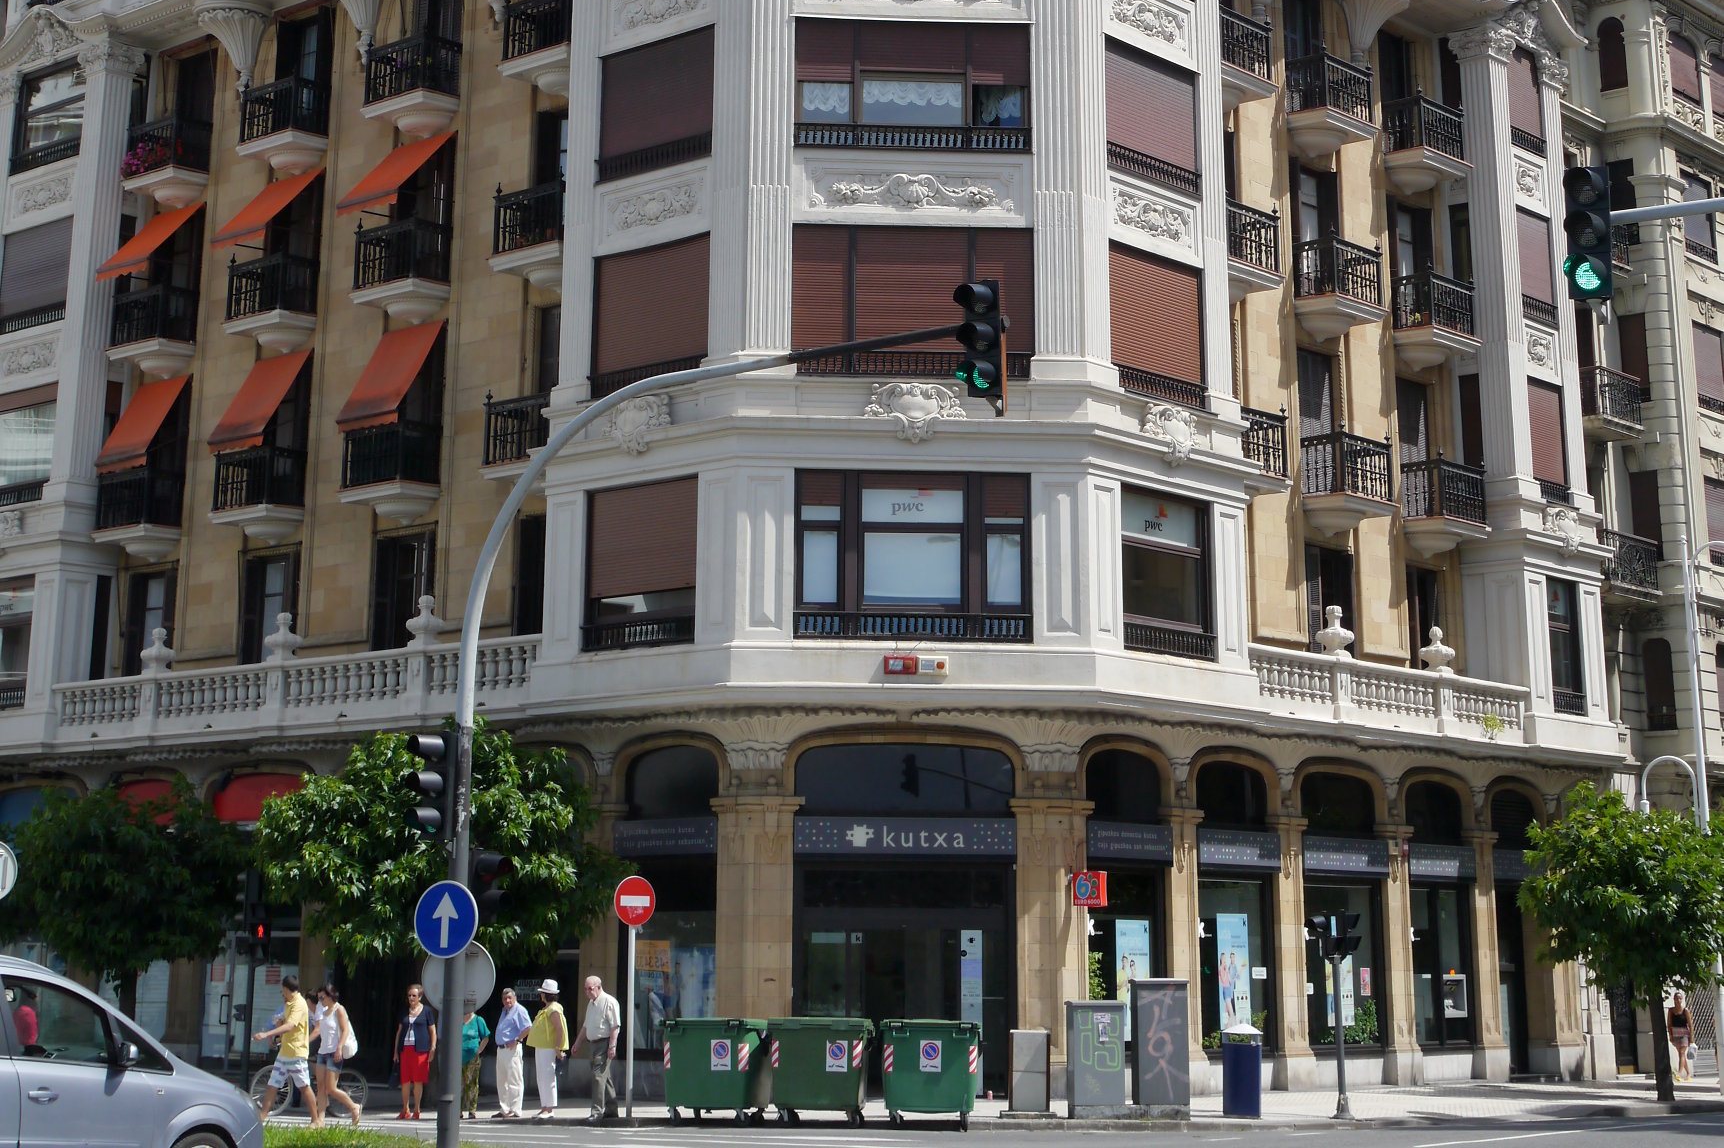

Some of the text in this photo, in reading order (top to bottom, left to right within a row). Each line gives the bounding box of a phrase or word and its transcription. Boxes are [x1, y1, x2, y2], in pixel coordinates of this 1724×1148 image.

[891, 502, 924, 516] pwc
[1144, 519, 1163, 532] pwc
[883, 825, 965, 848] kutxa
